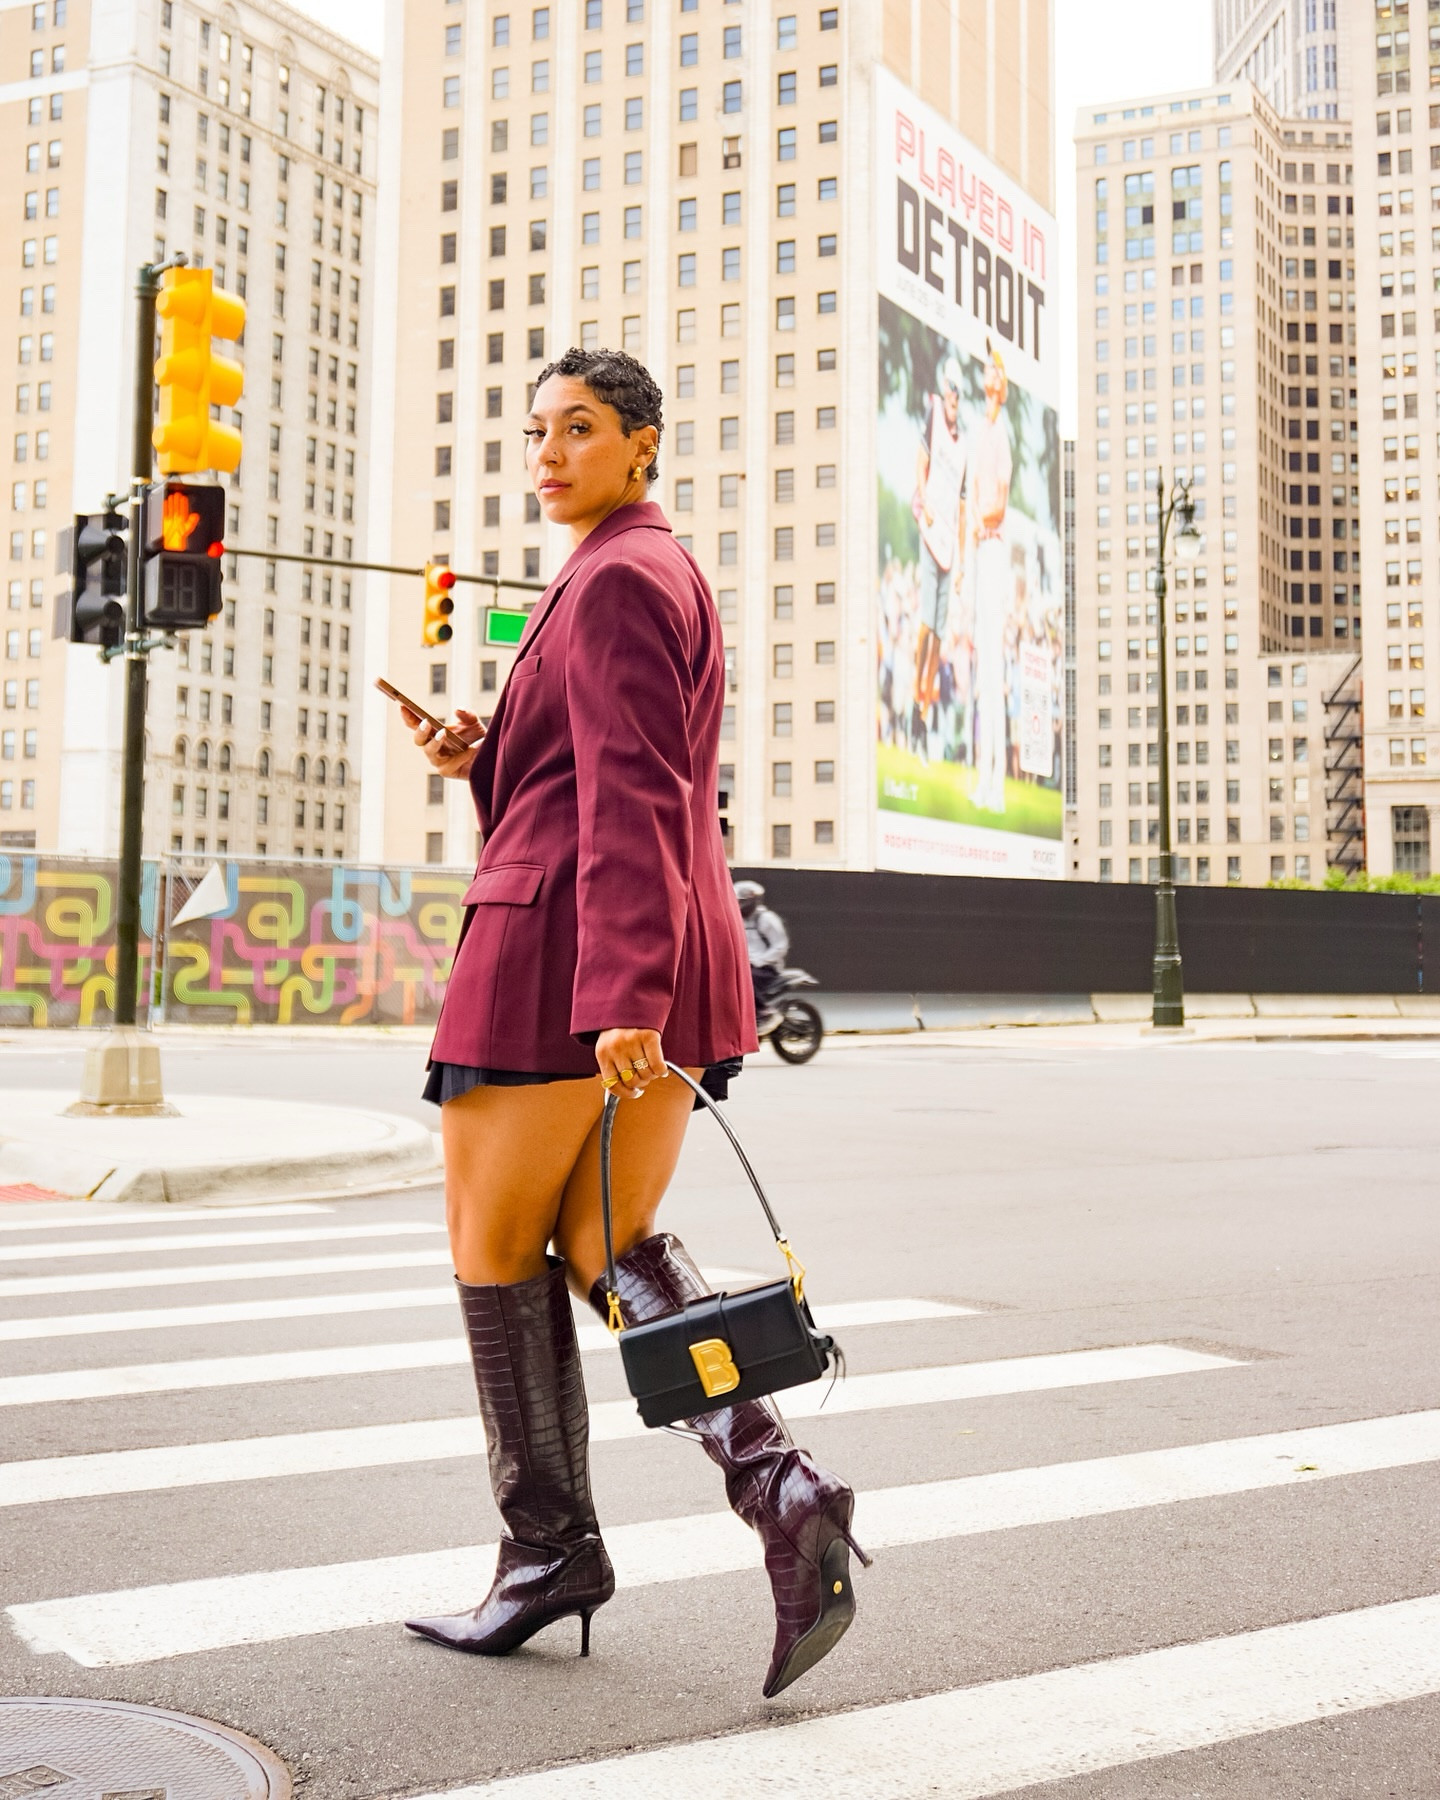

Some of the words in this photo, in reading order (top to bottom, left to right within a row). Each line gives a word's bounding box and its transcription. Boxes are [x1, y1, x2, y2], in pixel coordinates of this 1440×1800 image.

[896, 111, 1014, 252] PLAYED
[1023, 217, 1046, 279] IN
[897, 176, 1045, 361] DETROIT
[689, 1338, 741, 1398] B
